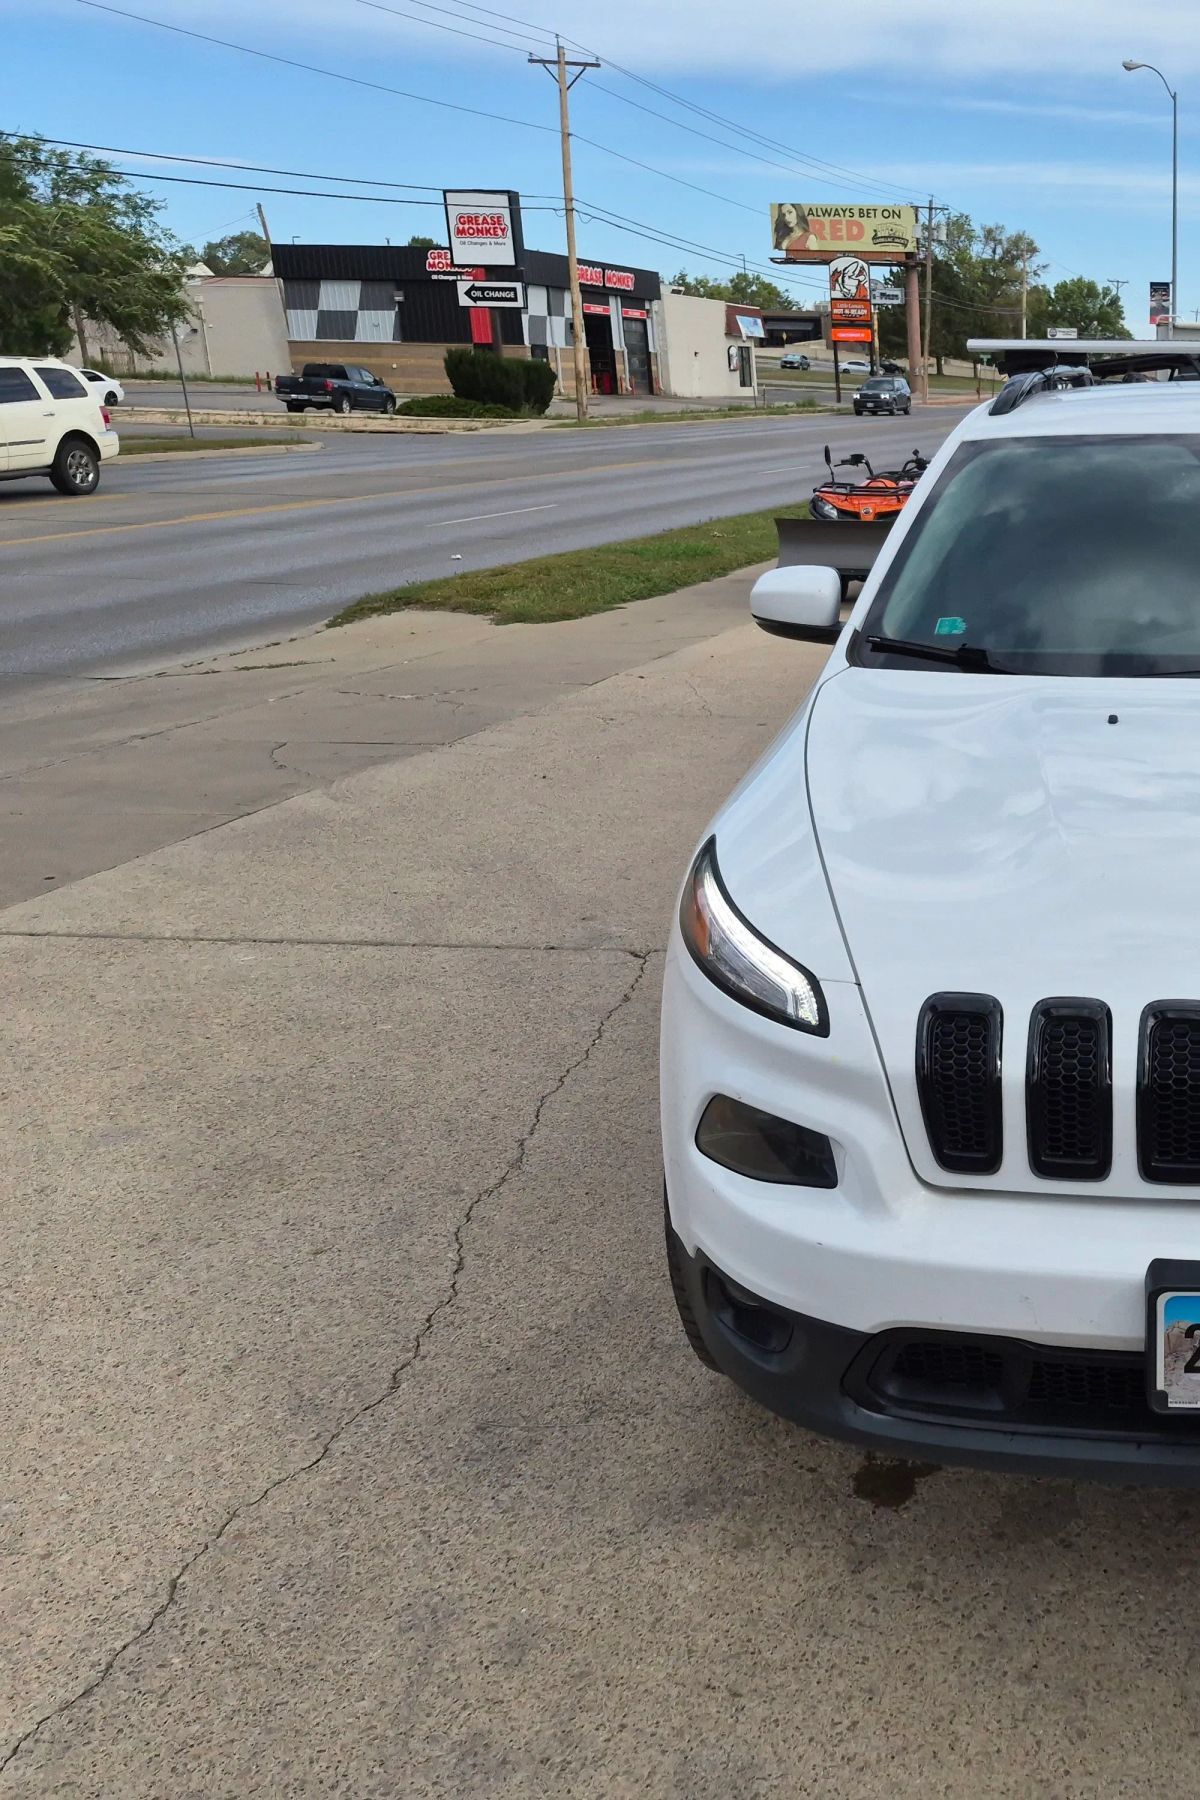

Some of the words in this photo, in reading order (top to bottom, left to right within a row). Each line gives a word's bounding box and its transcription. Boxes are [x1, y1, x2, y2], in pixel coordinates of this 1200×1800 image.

[807, 207, 855, 219] ALWAYS
[859, 208, 879, 219] BET
[881, 209, 901, 220] ON
[457, 214, 504, 226] GREASE
[455, 226, 508, 238] MONKEY
[809, 219, 865, 241] RED
[428, 251, 450, 261] GRE
[604, 269, 635, 291] MONKEY
[470, 290, 484, 298] OIL
[484, 290, 515, 299] CHANGE
